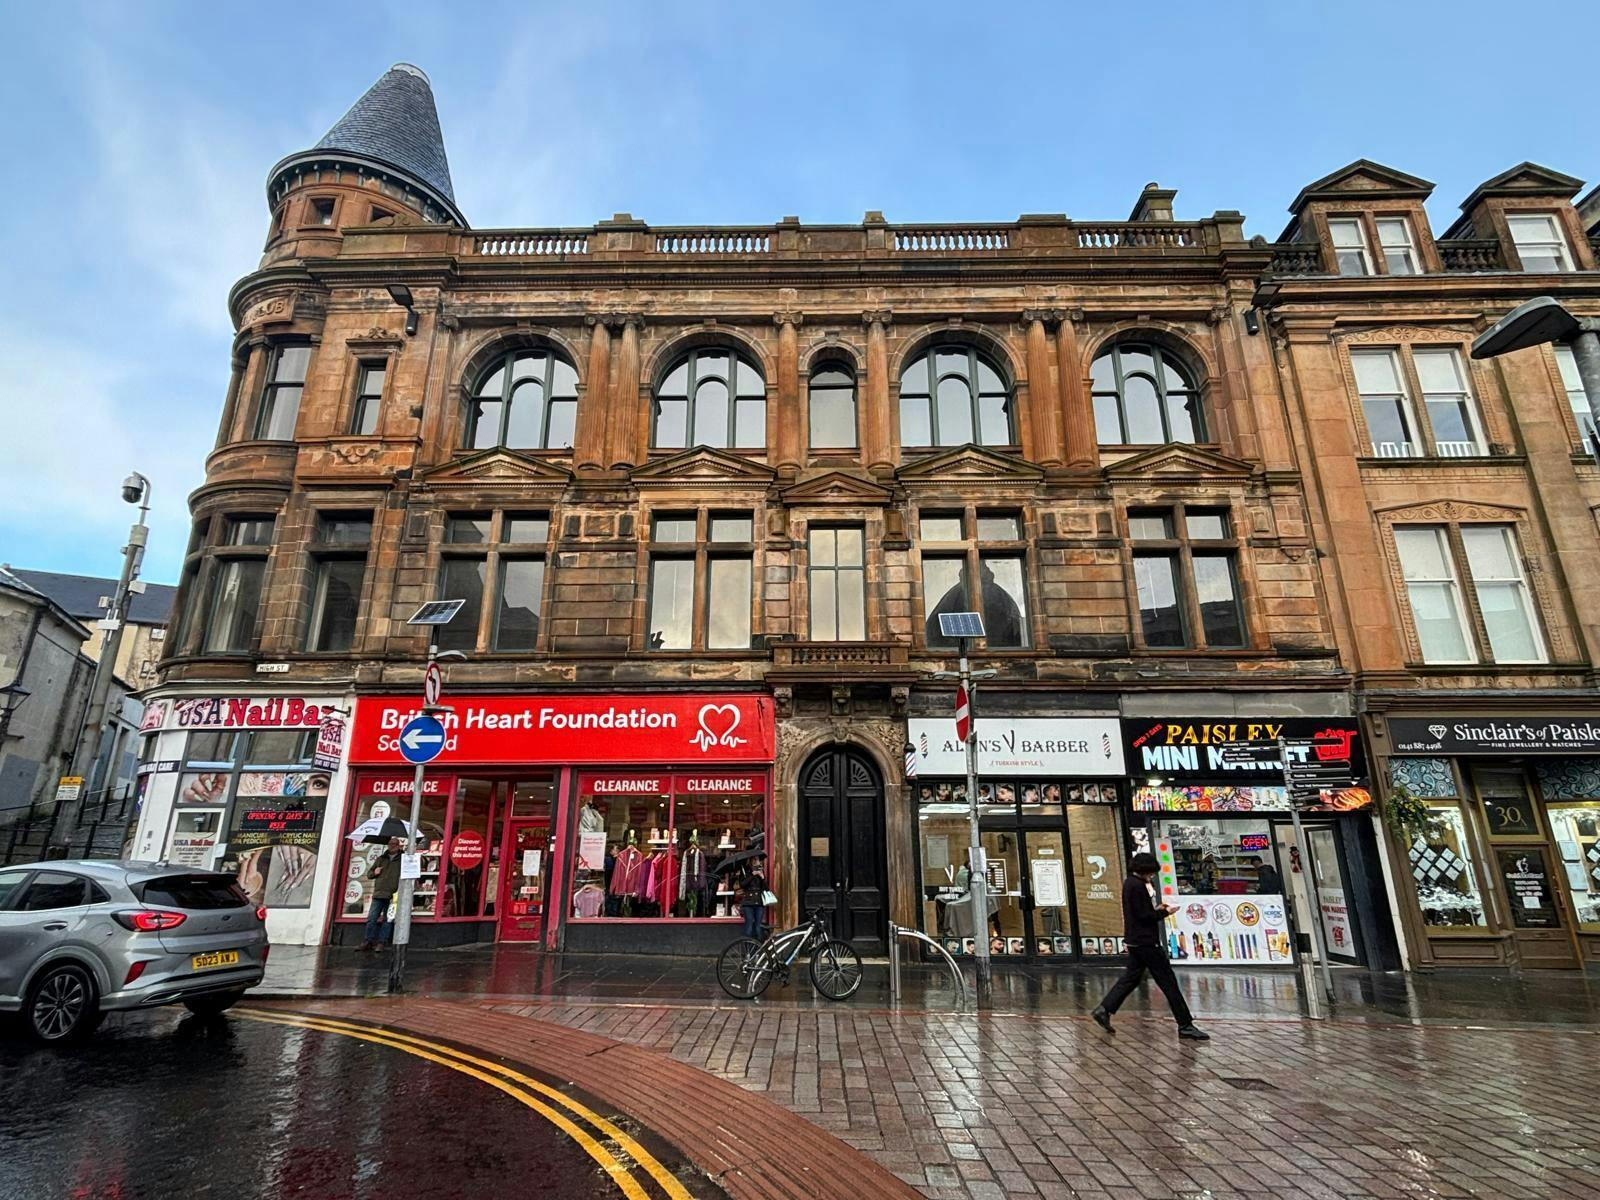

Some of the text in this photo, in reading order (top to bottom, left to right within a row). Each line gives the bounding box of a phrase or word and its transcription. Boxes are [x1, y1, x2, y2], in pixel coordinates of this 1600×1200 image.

[179, 698, 222, 727] USA
[224, 698, 283, 726] Nail
[466, 708, 532, 729] Heart
[539, 706, 677, 729] Foundation
[321, 725, 342, 744] USA
[1453, 722, 1536, 741] Sinclair's
[1536, 726, 1548, 741] of
[942, 740, 1089, 753] ALN'S BARBER
[1142, 745, 1199, 771] MINI
[373, 780, 439, 793] CLEARACE
[594, 779, 660, 792] CLEARANCE
[687, 779, 753, 792] CLEARANCE
[1495, 806, 1521, 827] 30
[1241, 838, 1269, 848] OPEN
[1090, 883, 1109, 892] GENTS
